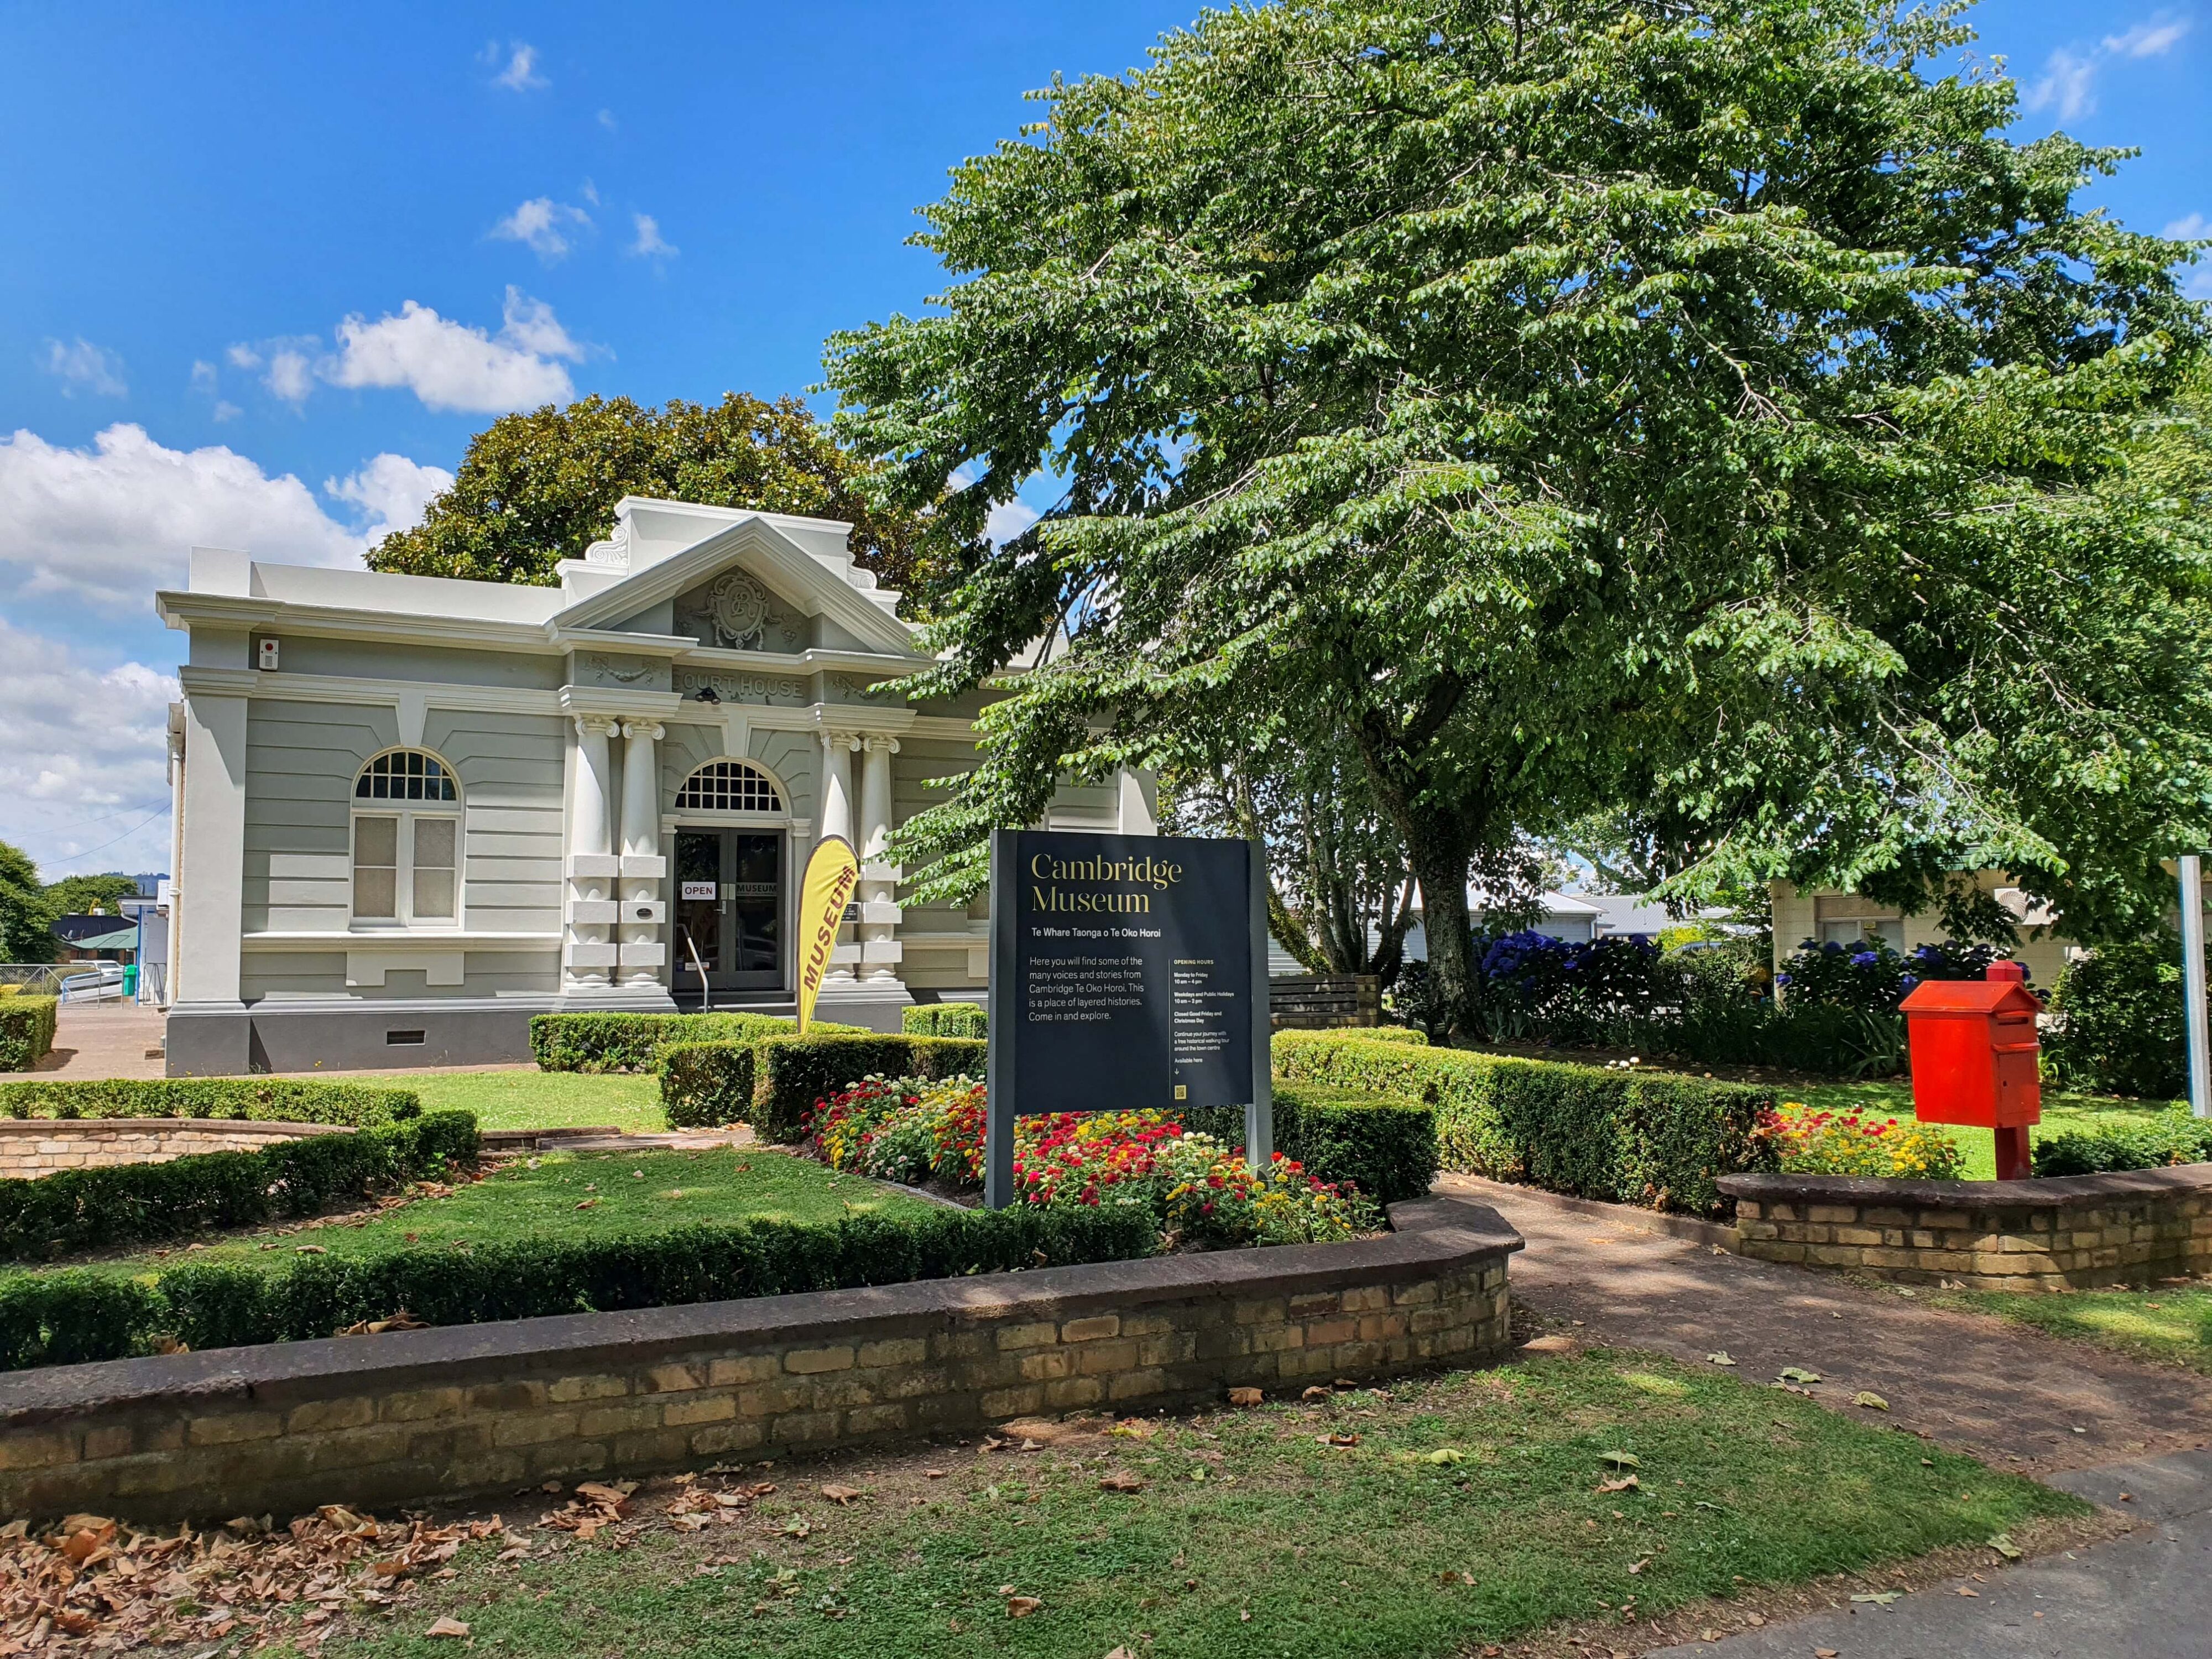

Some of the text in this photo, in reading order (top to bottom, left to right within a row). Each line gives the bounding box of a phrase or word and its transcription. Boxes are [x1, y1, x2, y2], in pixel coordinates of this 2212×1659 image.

[672, 672, 805, 698] COURT HOUSE
[1031, 853, 1182, 890] Cambridge
[685, 886, 713, 895] OPEN
[1031, 886, 1150, 912] Museum
[804, 865, 855, 991] MUSEUM
[1031, 927, 1041, 936] Te
[1044, 927, 1070, 937] Whare
[1072, 928, 1102, 938] Taonga
[1110, 928, 1120, 937] Te
[1121, 928, 1138, 937] Oko
[1140, 929, 1161, 937] Horoi
[1030, 957, 1050, 966] Here
[1051, 958, 1066, 968] you
[1067, 957, 1080, 965] will
[1082, 956, 1097, 965] find
[1121, 956, 1129, 965] of
[1130, 957, 1142, 965] the
[1029, 970, 1141, 982] many voices and stories from
[1029, 983, 1144, 995] Cambridge Te Oko Horoi. This
[1029, 998, 1036, 1007] is
[1044, 998, 1066, 1009] place
[1068, 998, 1076, 1006] of
[1078, 997, 1106, 1009] layered
[1108, 997, 1142, 1006] histories.
[1029, 1011, 1111, 1021] Come in and explore.
